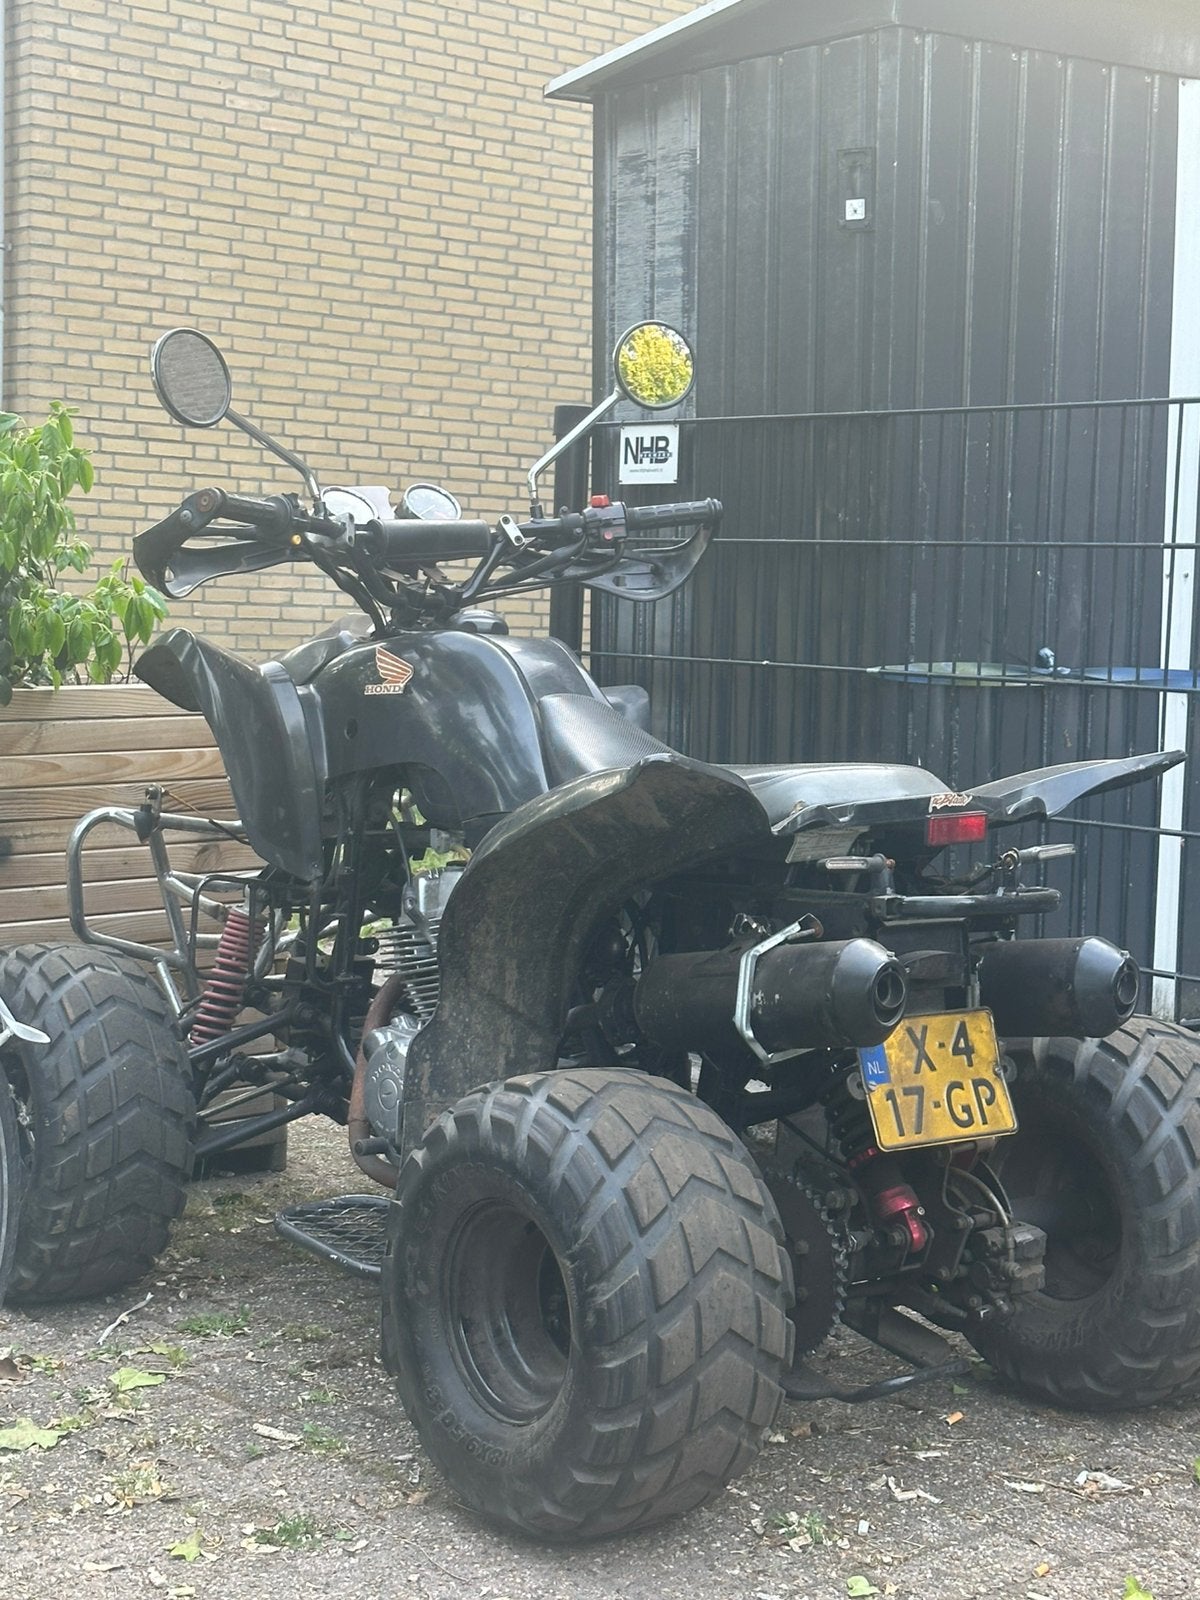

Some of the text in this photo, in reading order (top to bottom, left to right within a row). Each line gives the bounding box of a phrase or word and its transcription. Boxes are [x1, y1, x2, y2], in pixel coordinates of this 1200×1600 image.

[624, 435, 671, 465] NHB
[867, 1060, 885, 1075] NL
[906, 1020, 975, 1074] X-4
[886, 1077, 997, 1137] 17-GP
